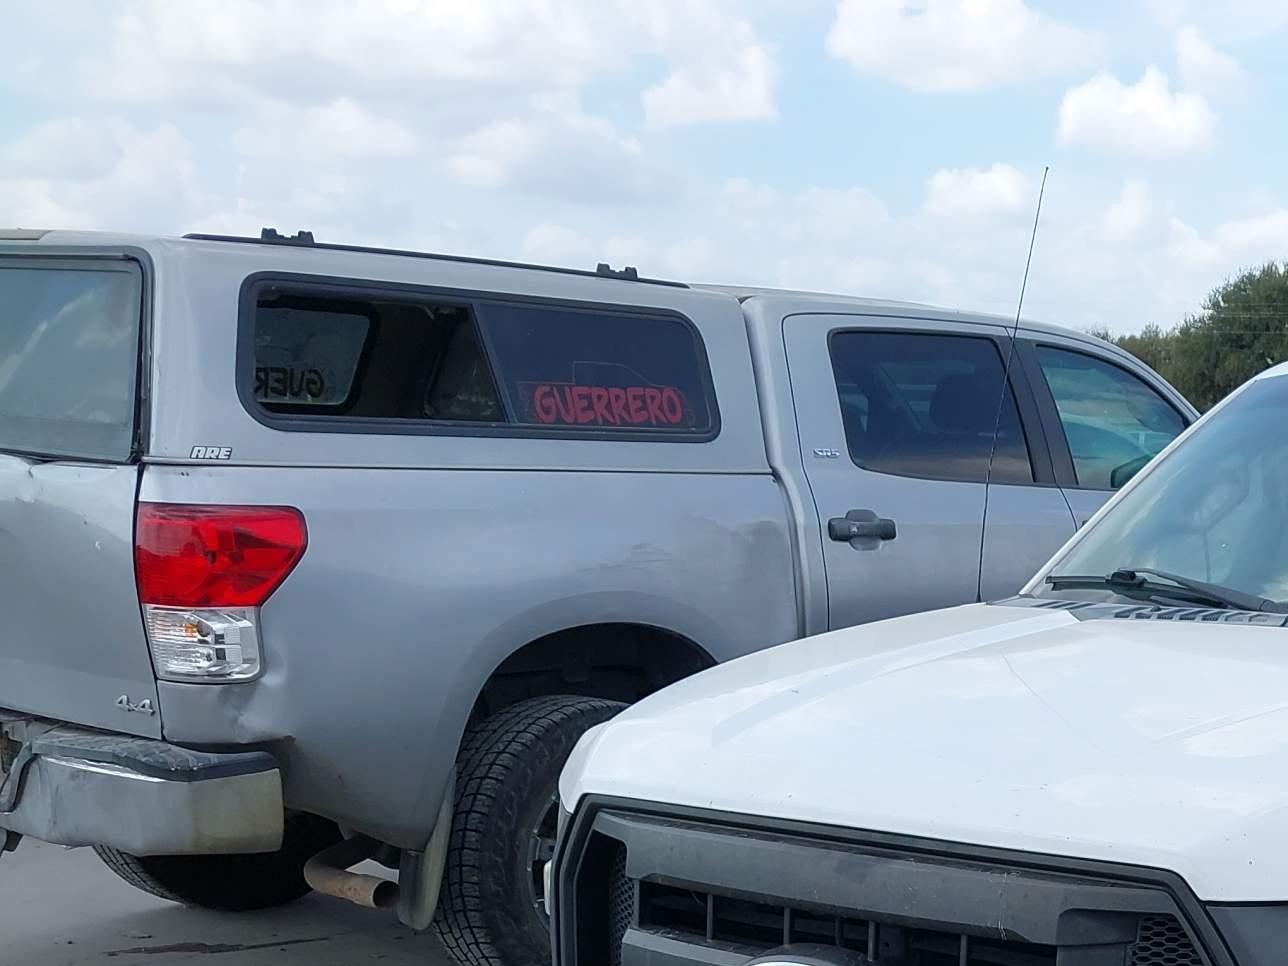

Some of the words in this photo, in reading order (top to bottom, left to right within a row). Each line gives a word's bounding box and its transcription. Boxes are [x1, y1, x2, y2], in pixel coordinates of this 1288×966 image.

[534, 385, 684, 425] GUERRERO
[191, 446, 232, 459] ARE
[116, 695, 155, 714] 4x4
